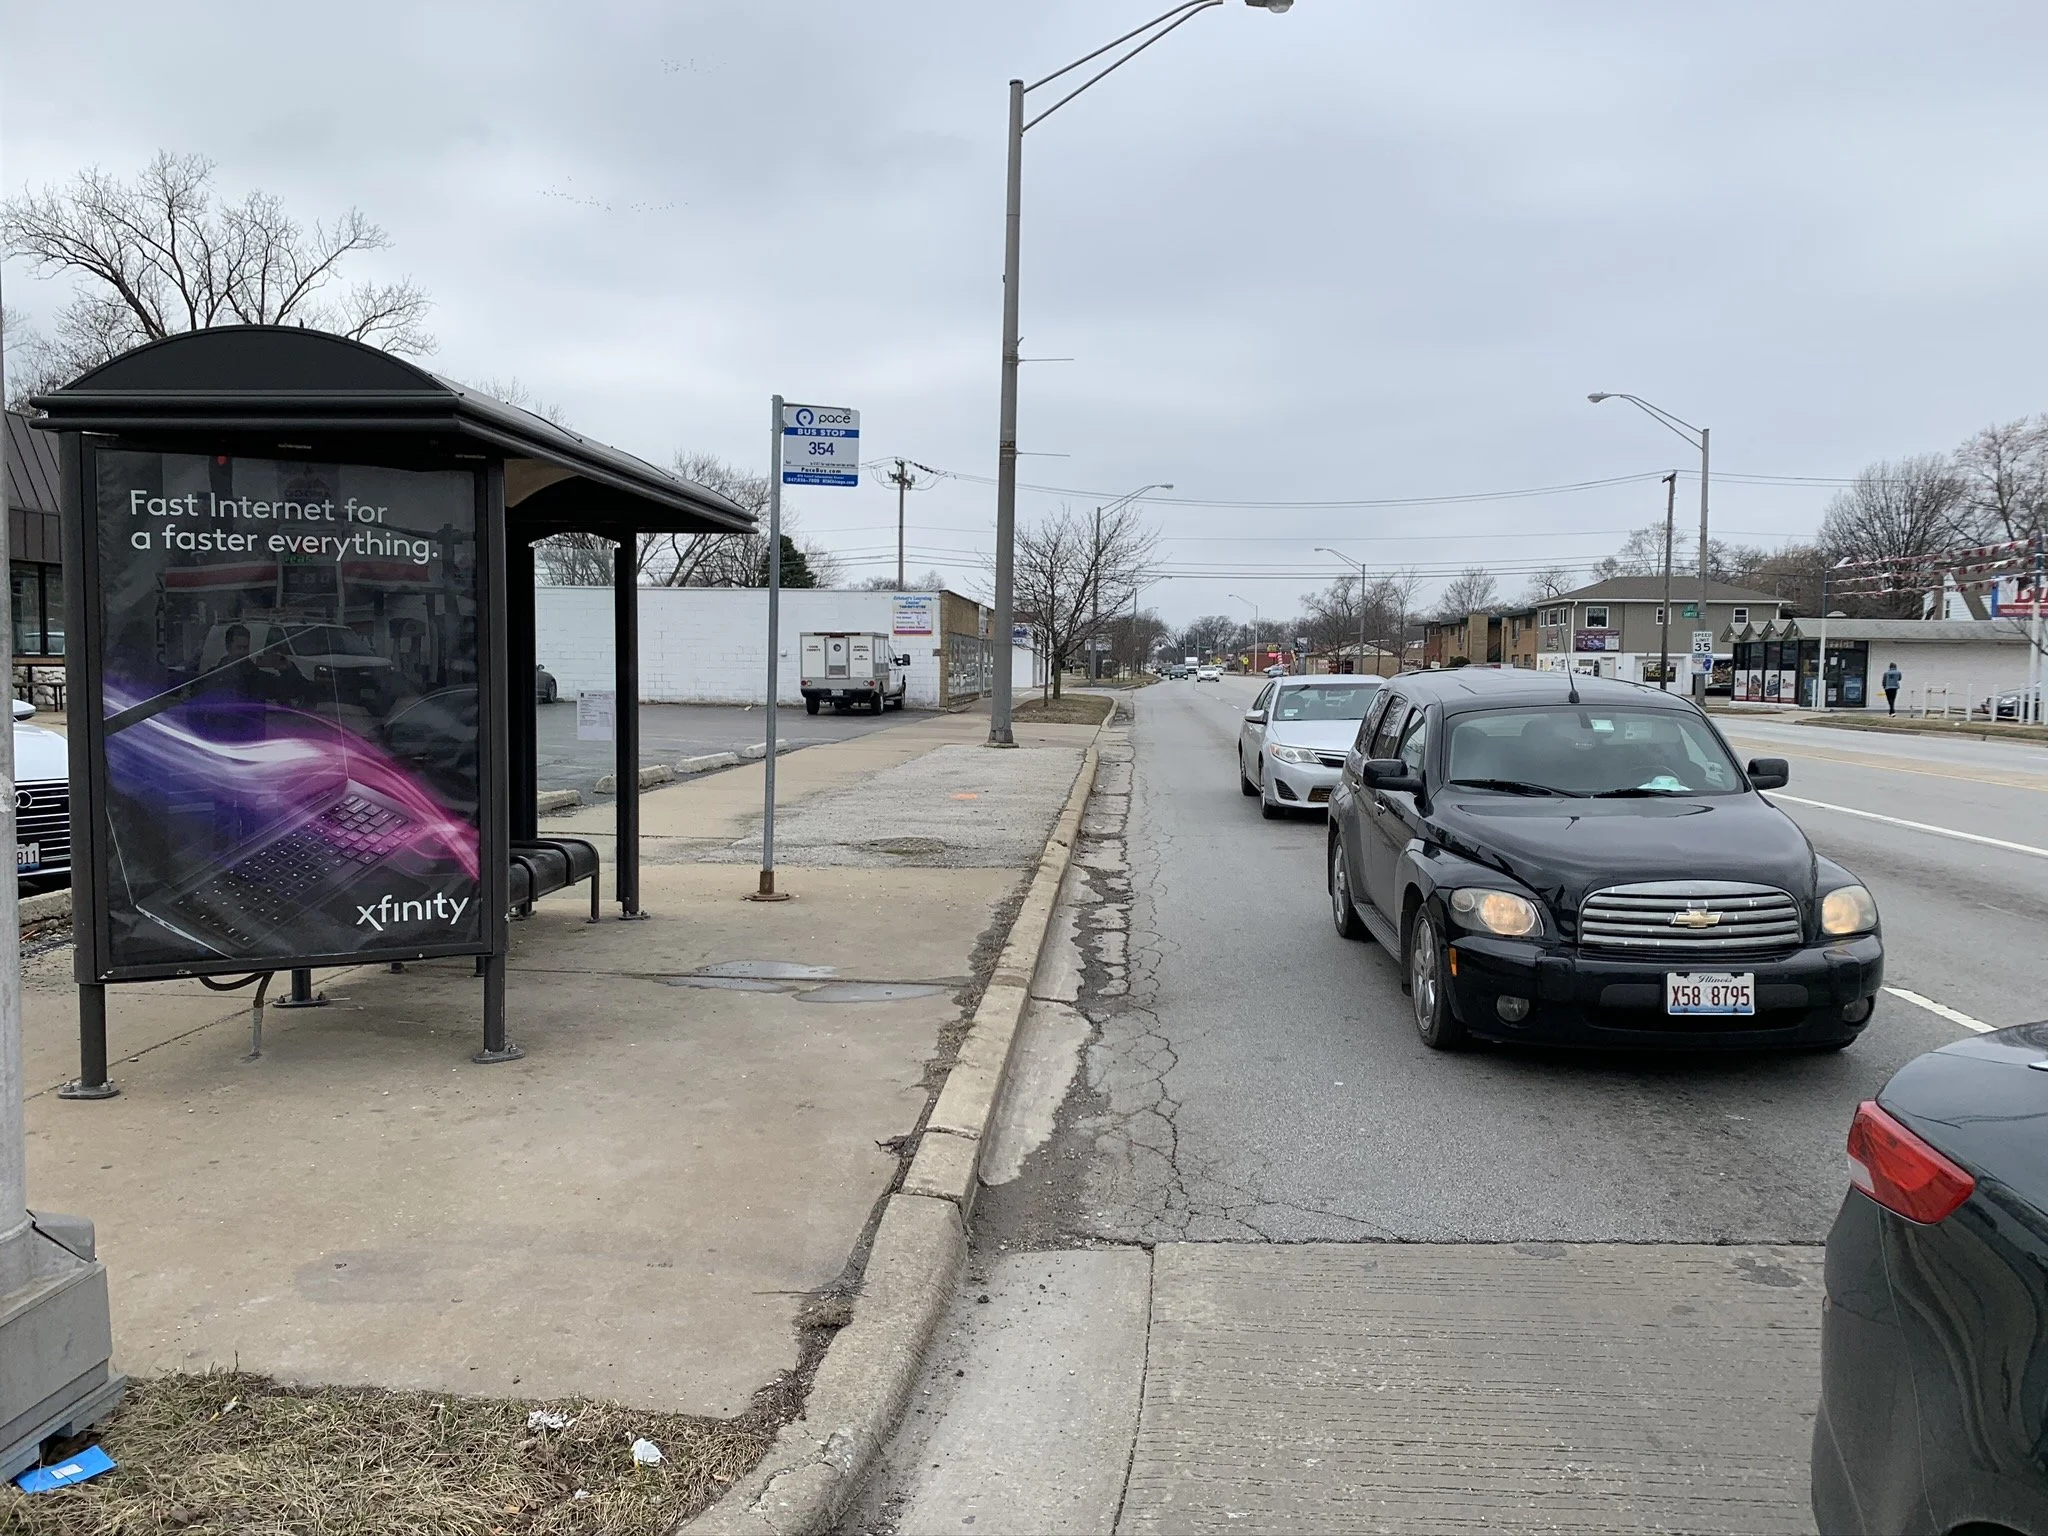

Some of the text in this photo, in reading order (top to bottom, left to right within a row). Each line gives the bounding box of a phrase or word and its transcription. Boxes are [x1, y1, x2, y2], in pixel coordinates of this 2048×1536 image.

[818, 414, 851, 424] pace
[797, 428, 846, 437] BUS STOP
[808, 441, 835, 456] 354
[130, 489, 388, 524] Fast Internet for
[130, 524, 439, 566] a faster everything.
[1694, 642, 1711, 652] 35
[356, 891, 470, 932] xfinity
[1698, 975, 1733, 984] Illinois
[1671, 985, 1750, 1007] X58 8795
